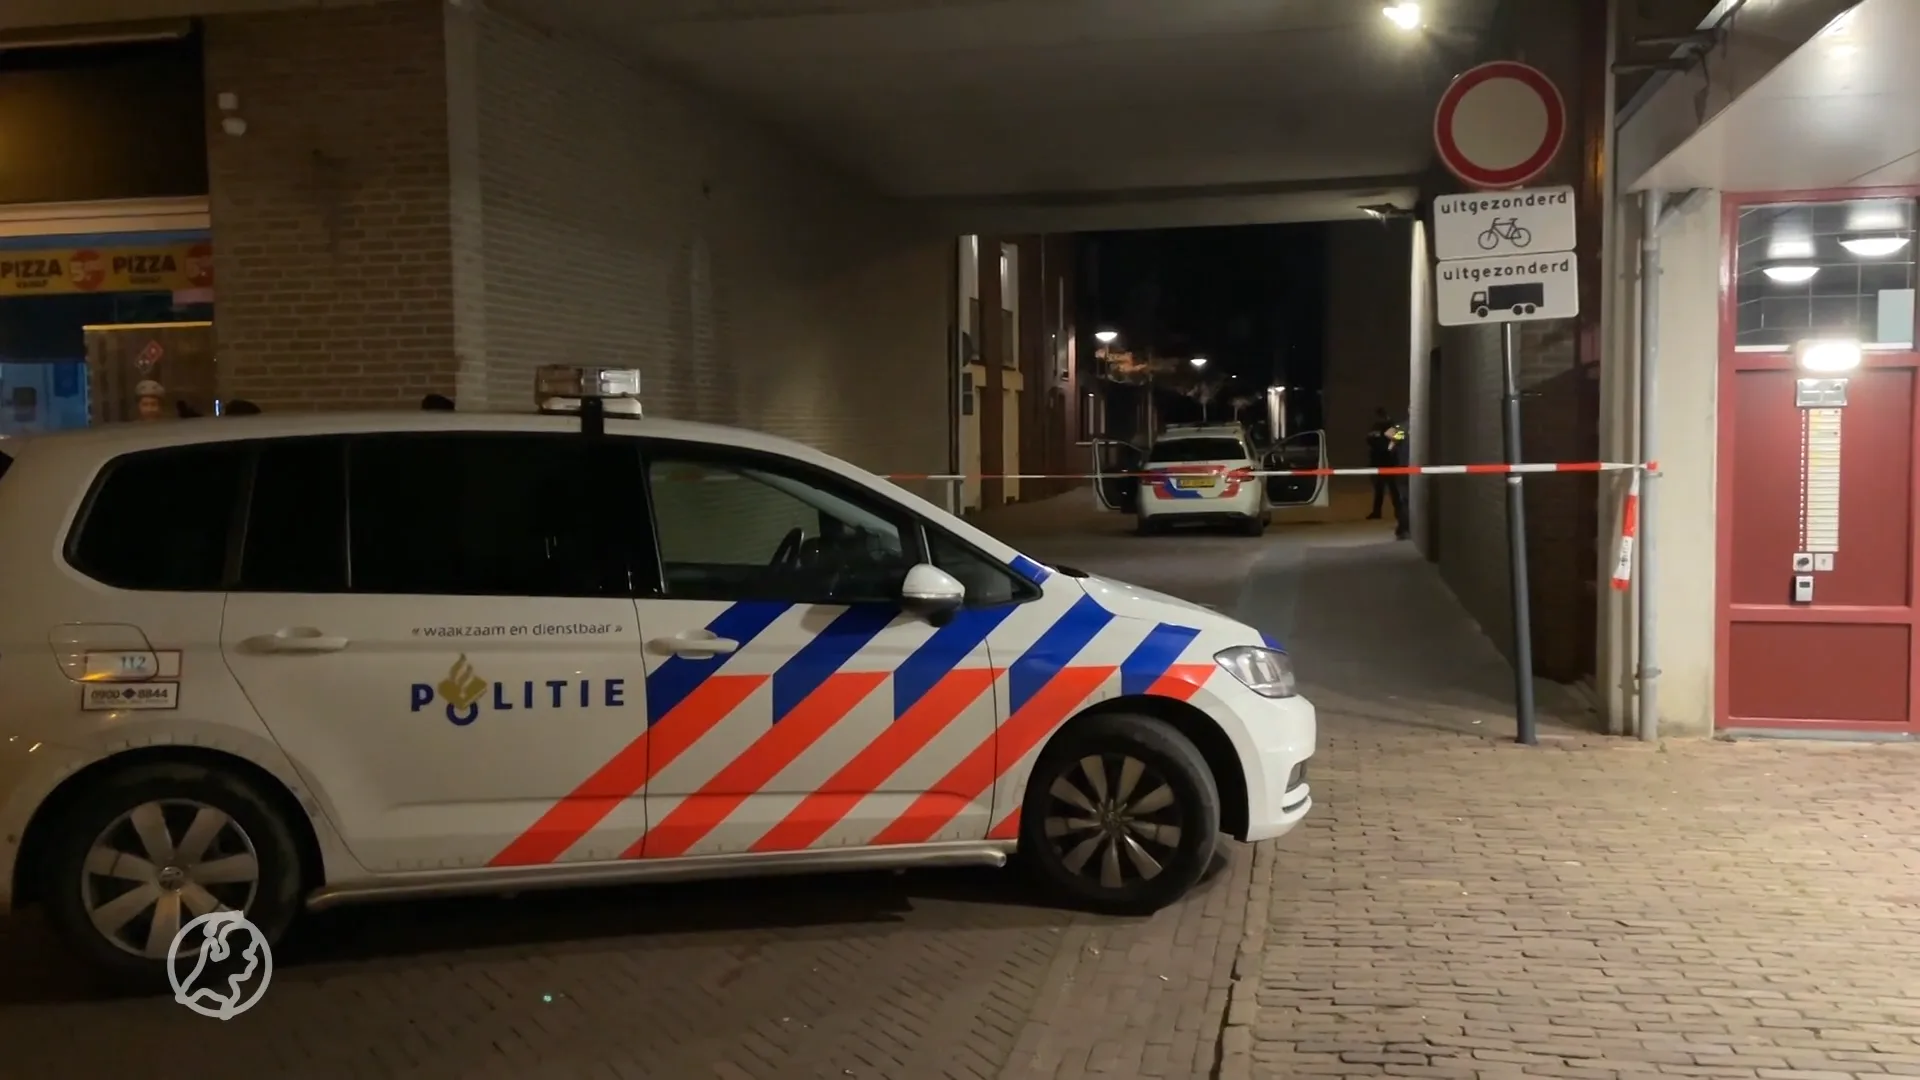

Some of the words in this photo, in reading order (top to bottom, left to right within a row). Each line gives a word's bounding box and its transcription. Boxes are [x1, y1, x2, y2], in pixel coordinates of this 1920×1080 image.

[1441, 191, 1567, 216] uitgezonderd
[1, 259, 63, 279] PIZZA
[113, 255, 177, 275] PIZZA
[1443, 259, 1569, 282] uitgezonderd
[424, 624, 505, 637] waakzaam
[510, 624, 527, 636] en
[532, 622, 611, 636] dienstbaar
[120, 655, 147, 670] 112
[410, 678, 625, 726] POLITIE
